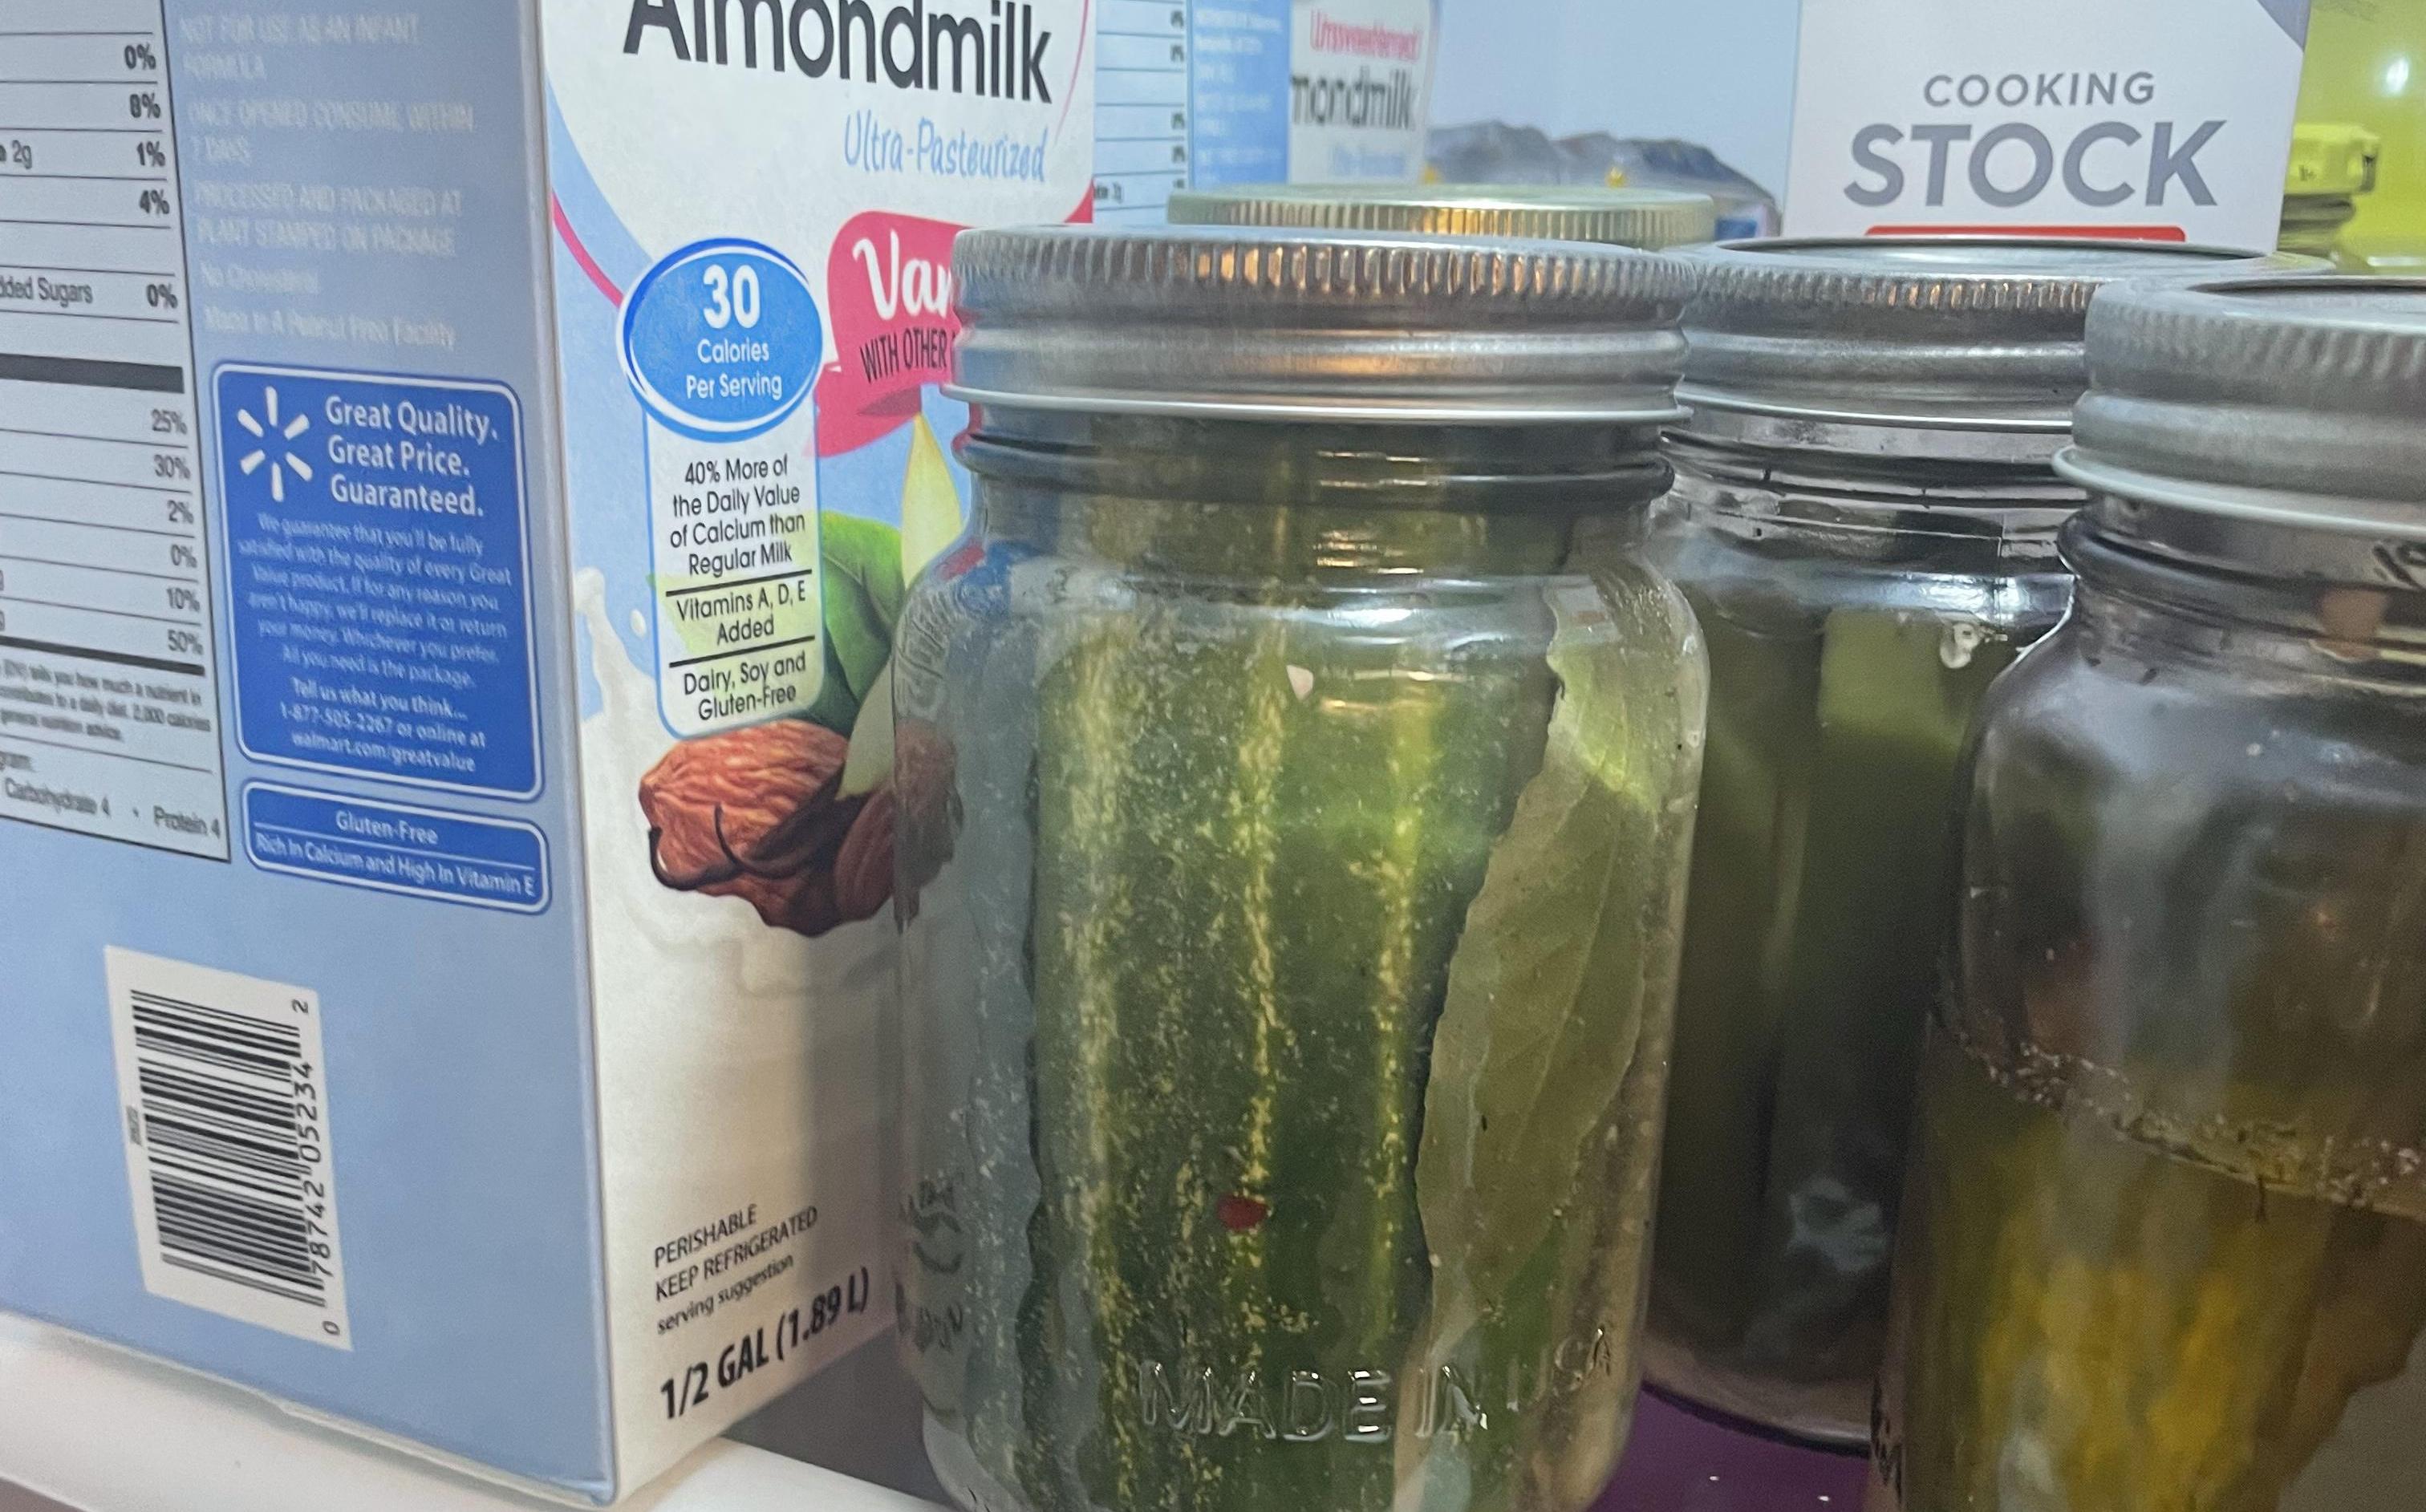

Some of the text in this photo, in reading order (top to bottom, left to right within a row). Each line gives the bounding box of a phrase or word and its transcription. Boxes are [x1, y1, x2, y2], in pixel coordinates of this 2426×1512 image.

[124, 43, 156, 71] 0%
[623, 0, 1052, 103] Almondmilk
[1923, 71, 2156, 107] COOKING
[12, 140, 166, 169] 2g 1%
[843, 108, 1048, 183] Ultra-Pasteurized
[1844, 119, 2228, 208] STOCK
[139, 189, 170, 215] 4%
[38, 277, 93, 308] Sugars
[147, 283, 177, 309] 0%
[703, 263, 761, 330] 30
[696, 337, 769, 365] Calories
[859, 326, 948, 383] WITH OTHER
[686, 373, 783, 402] Per Serving
[151, 408, 188, 436] 25%
[325, 395, 499, 446] Great Quality.
[153, 453, 191, 480] 30%
[328, 434, 471, 478] Great Price.
[684, 452, 788, 485] 40% More of
[167, 499, 194, 525] 2%
[331, 473, 485, 517] Guaranteed.
[672, 483, 800, 517] the Daily Value
[670, 513, 805, 549] of Calcium than
[170, 543, 197, 569] 0%
[469, 561, 512, 586] Great
[688, 539, 793, 579] Regular Milk
[167, 586, 201, 612] 10%
[675, 580, 806, 622] Vitamins A, D, E
[167, 628, 203, 655] 50%
[716, 614, 775, 647] Added
[683, 650, 807, 696] Dairy, Soy and
[291, 676, 318, 700] Tell
[318, 683, 338, 702] us
[339, 684, 377, 708] what
[379, 693, 409, 714] you
[698, 683, 797, 722] Gluten-Free
[291, 730, 477, 772] walmart.com/greatvalue
[396, 718, 413, 738] or
[416, 723, 467, 746] online
[469, 731, 486, 748] at
[153, 804, 209, 836] Protein
[336, 809, 439, 846] Gluten-Free
[255, 831, 286, 857] Rich
[305, 840, 364, 870] Calcium
[366, 853, 396, 875] and
[397, 856, 435, 886] High
[456, 865, 521, 894] Vitamin
[525, 875, 535, 898] E
[291, 997, 343, 1338] 0 78742 05234 2
[654, 1202, 758, 1268] PERISHABLE
[655, 1205, 818, 1303] KEEP REFRIGERATED
[657, 1254, 794, 1336] serving suggestion
[660, 1266, 870, 1420] 1/2 GAL (1.89 L)
[1139, 1360, 1392, 1444] MADE
[1414, 1362, 1489, 1440] IN
